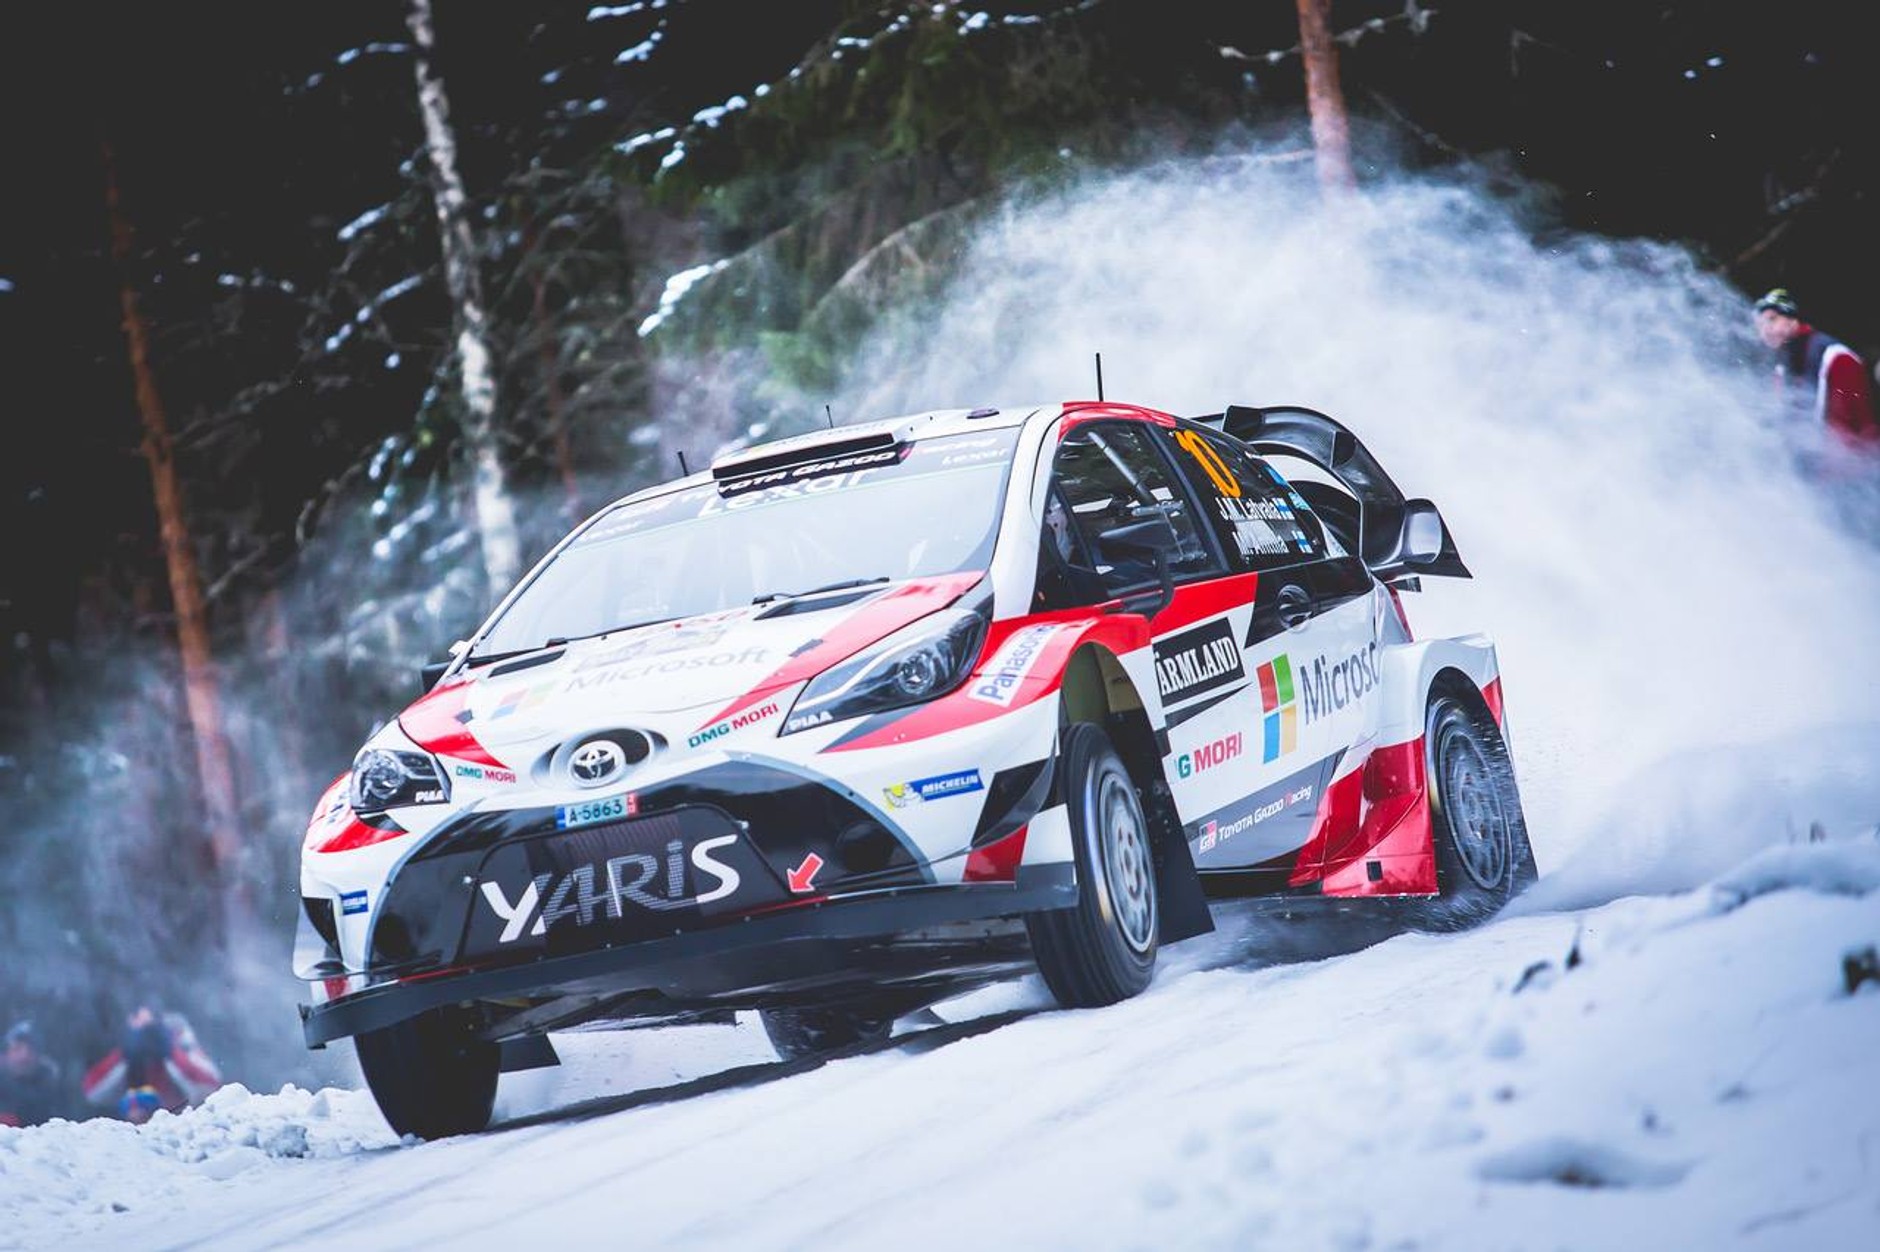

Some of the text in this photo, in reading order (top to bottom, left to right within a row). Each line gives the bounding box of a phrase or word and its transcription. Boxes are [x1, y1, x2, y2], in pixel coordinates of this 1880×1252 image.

[1174, 429, 1241, 498] 10
[564, 647, 768, 693] Microsoft
[977, 624, 1057, 701] Panaso
[688, 702, 779, 748] DMG MORI
[789, 710, 833, 731] PIAA
[1194, 732, 1242, 773] MORI
[456, 765, 516, 783] DMG MORI
[922, 774, 979, 794] MICHELIN
[415, 790, 445, 803] PIAA
